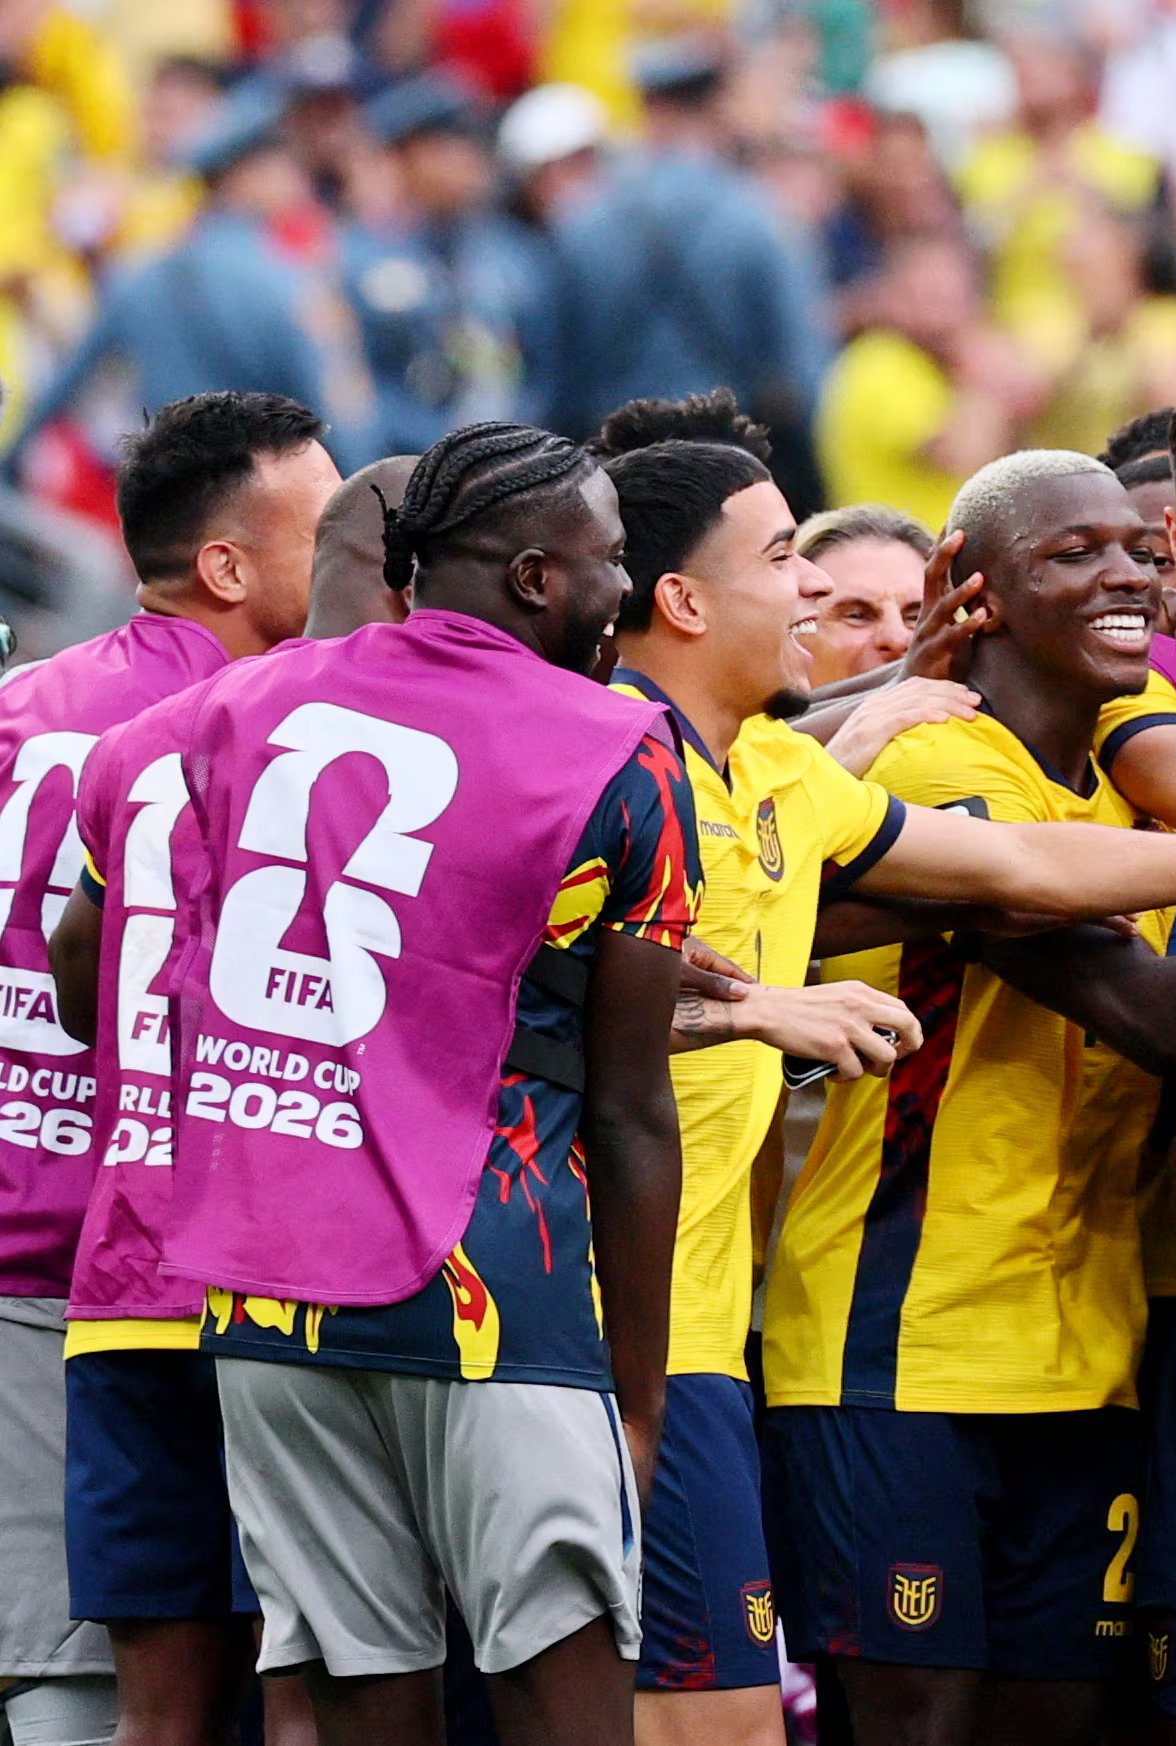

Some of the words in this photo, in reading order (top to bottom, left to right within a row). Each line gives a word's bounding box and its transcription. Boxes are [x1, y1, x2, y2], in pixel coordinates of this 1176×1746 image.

[265, 966, 334, 1014] FIFA
[31, 1069, 97, 1104] CUP
[195, 1033, 310, 1081] WORLD
[313, 1060, 361, 1097] CUP
[185, 1071, 365, 1150] 2026
[1103, 1493, 1139, 1603] 2
